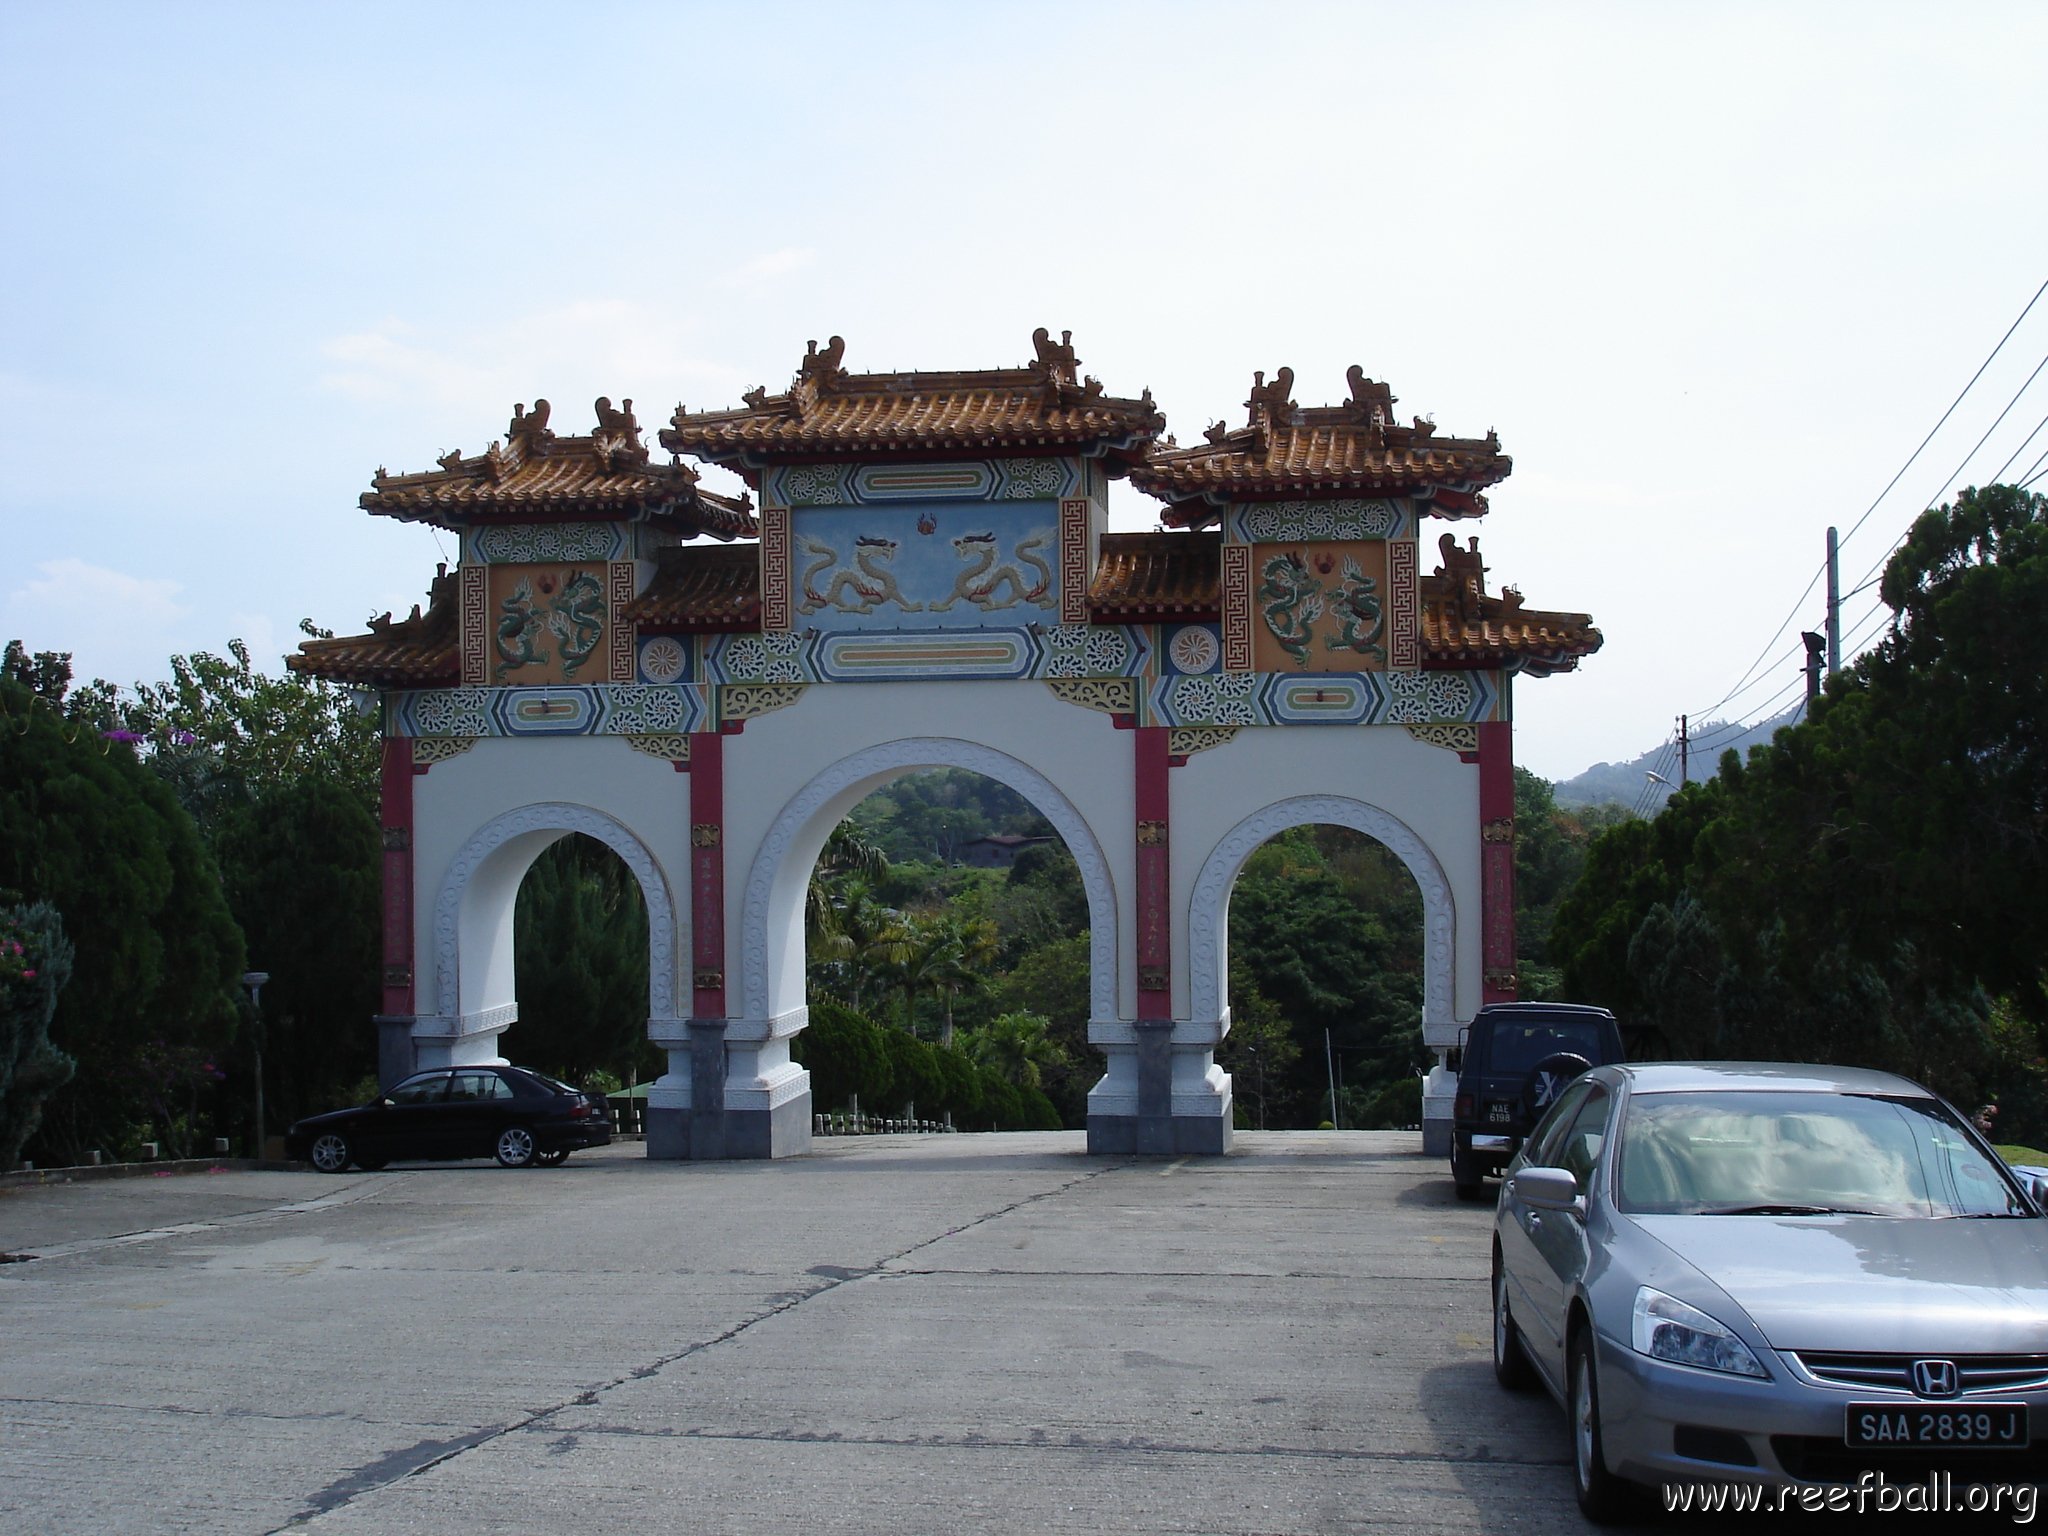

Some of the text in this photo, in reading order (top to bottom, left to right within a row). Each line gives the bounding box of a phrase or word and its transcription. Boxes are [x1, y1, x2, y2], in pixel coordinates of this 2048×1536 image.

[1491, 1104, 1509, 1113] NAE
[1489, 1113, 1511, 1122] 6198
[1861, 1413, 2015, 1441] SAA 2839 J
